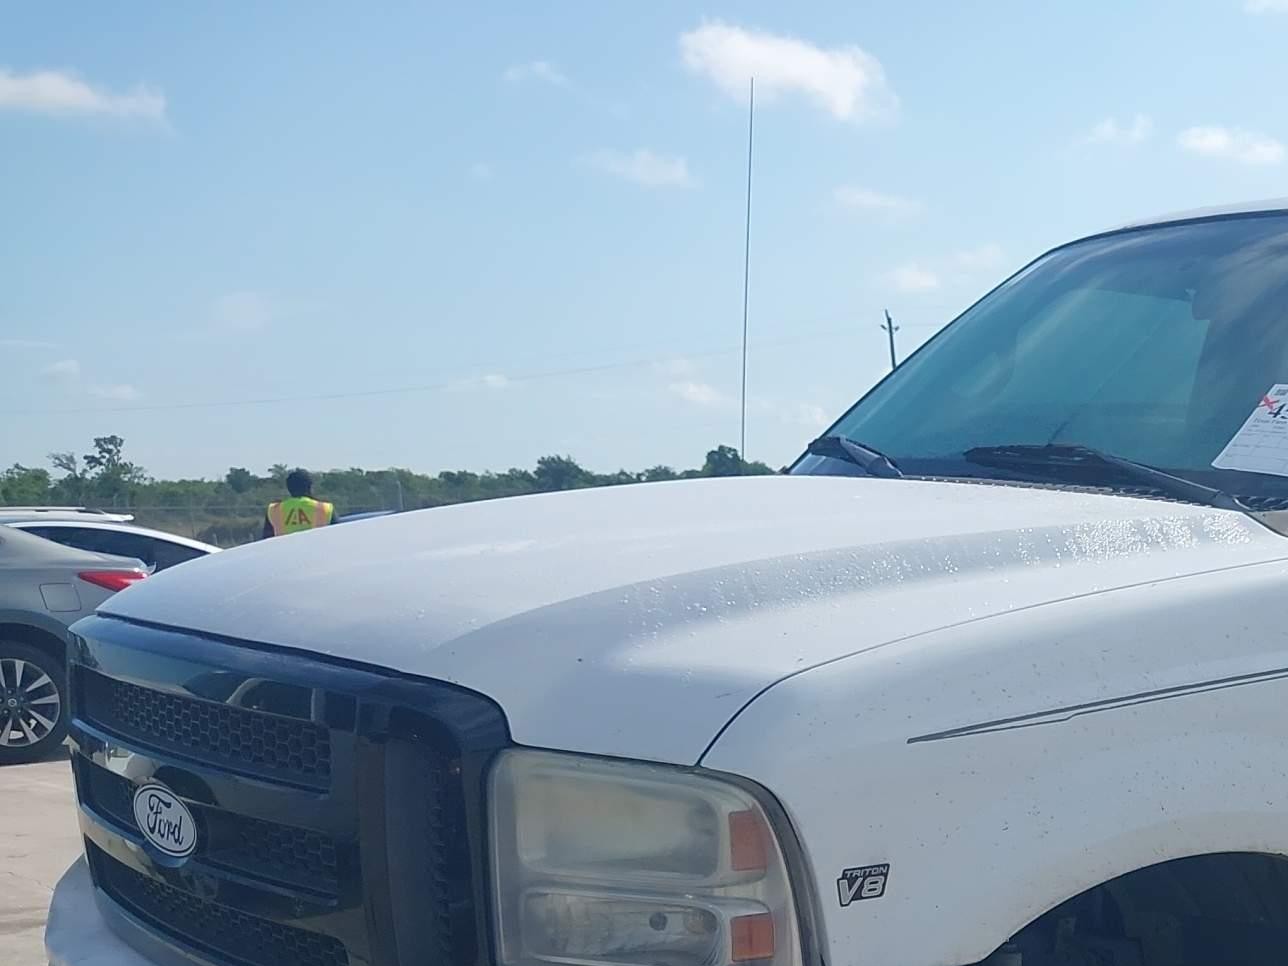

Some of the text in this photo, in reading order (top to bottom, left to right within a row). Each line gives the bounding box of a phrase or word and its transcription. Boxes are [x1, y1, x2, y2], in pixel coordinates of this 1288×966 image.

[147, 794, 185, 846] Ford
[844, 865, 888, 879] TRITON
[838, 875, 886, 906] V8
